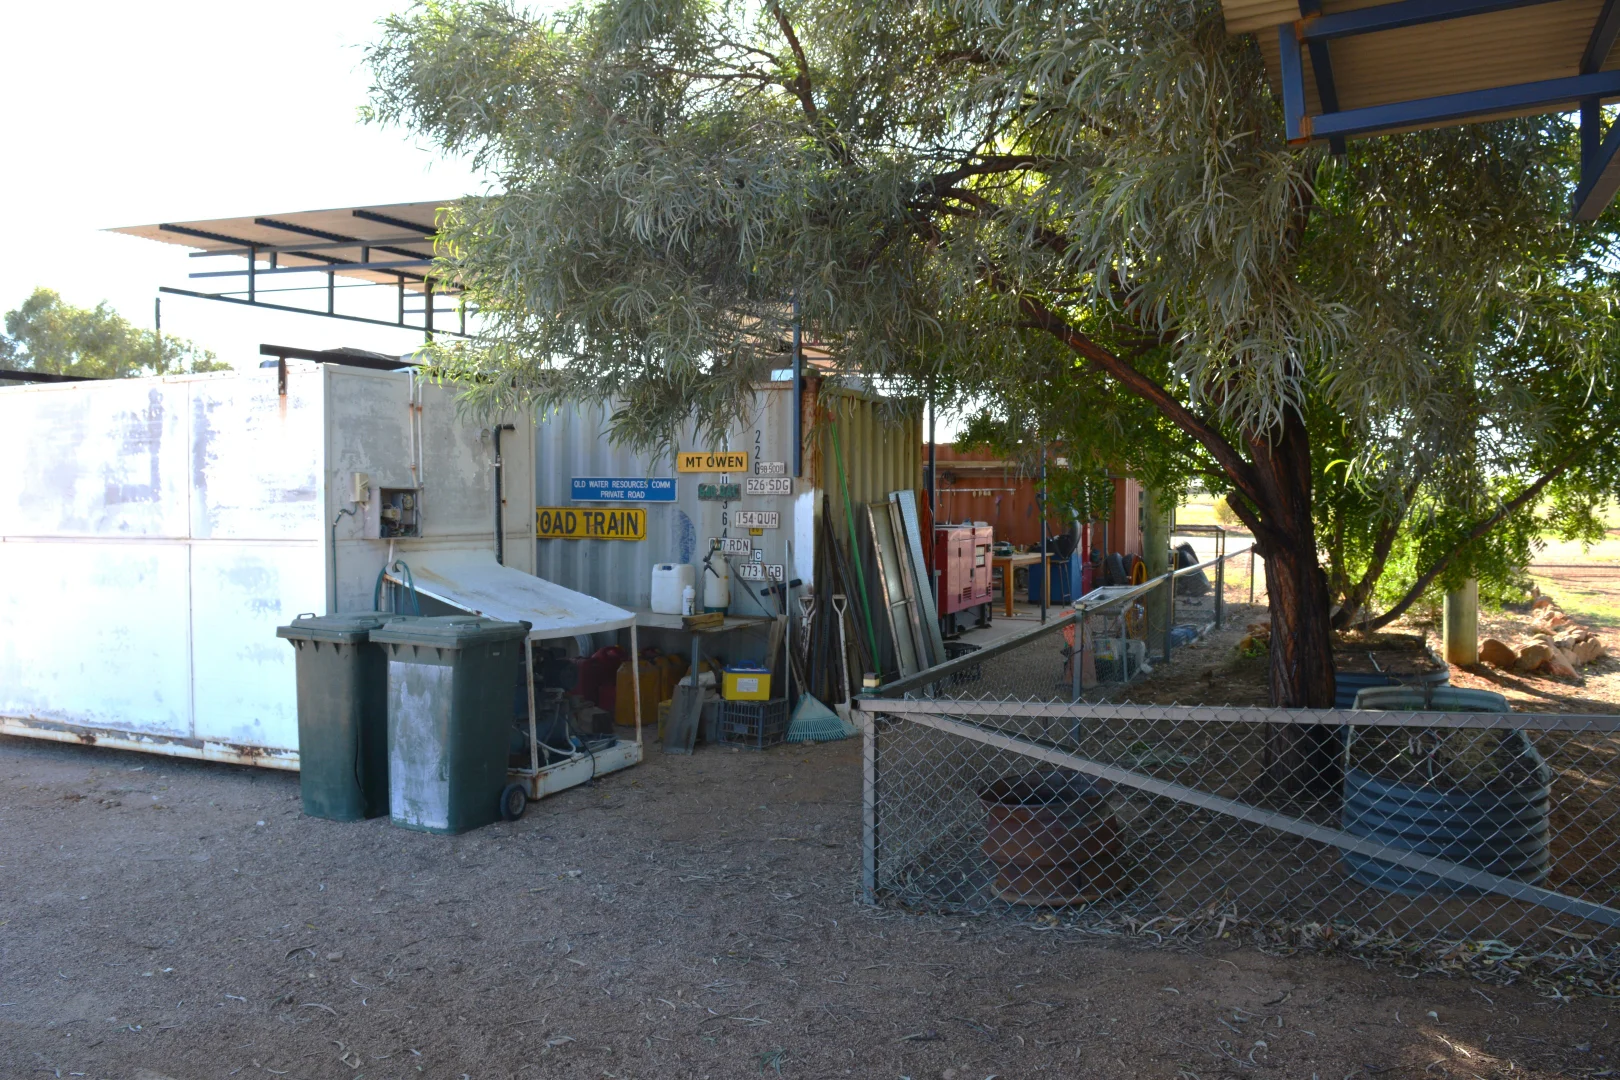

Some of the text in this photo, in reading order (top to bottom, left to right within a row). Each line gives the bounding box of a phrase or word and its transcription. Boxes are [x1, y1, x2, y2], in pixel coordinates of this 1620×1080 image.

[685, 456, 744, 468] MT OWEN
[589, 481, 609, 489] WATER
[611, 481, 649, 489] RESOURCES
[651, 481, 671, 489] COMM
[600, 490, 646, 499] PRIVATE ROAD
[536, 510, 639, 536] OAD TRAIN
